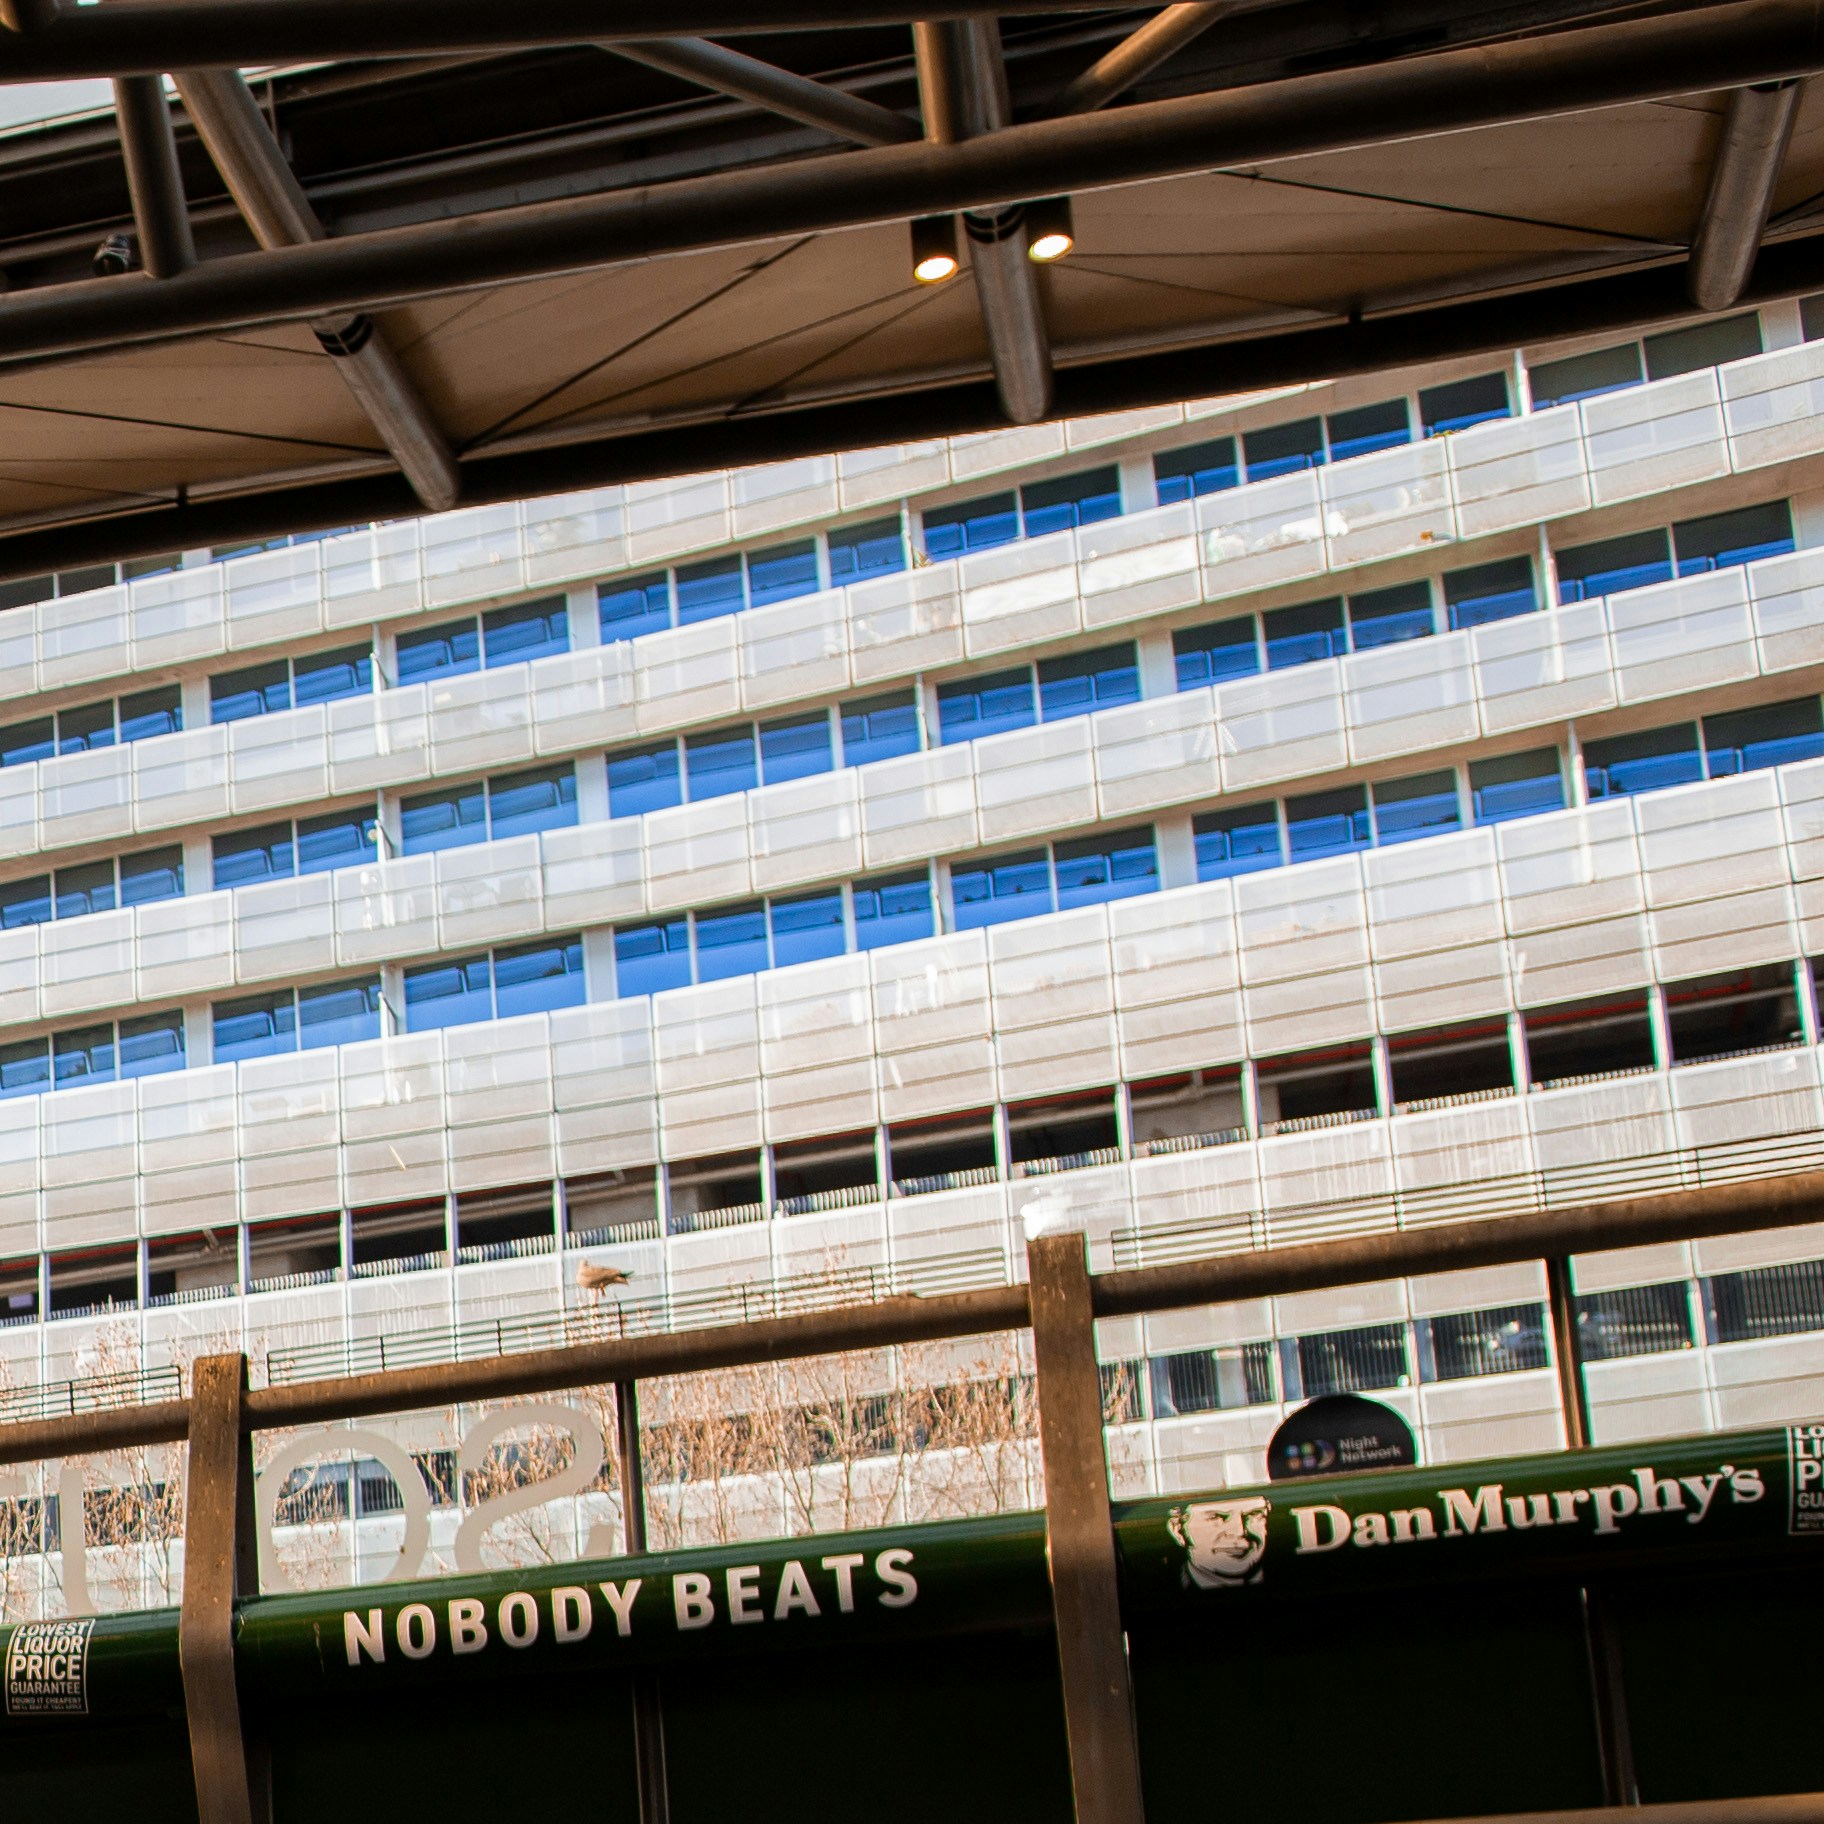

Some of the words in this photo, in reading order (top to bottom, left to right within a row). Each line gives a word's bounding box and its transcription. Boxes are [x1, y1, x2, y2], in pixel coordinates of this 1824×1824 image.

[1338, 1435, 1378, 1450] Night
[1340, 1445, 1402, 1463] Network
[344, 1579, 643, 1666] NOBODY
[673, 1548, 918, 1631] BEATS
[17, 1621, 89, 1637] LOWEST
[12, 1635, 84, 1654] LIQUOR
[10, 1654, 81, 1680] PRICE
[10, 1681, 81, 1694] GUARANTEE
